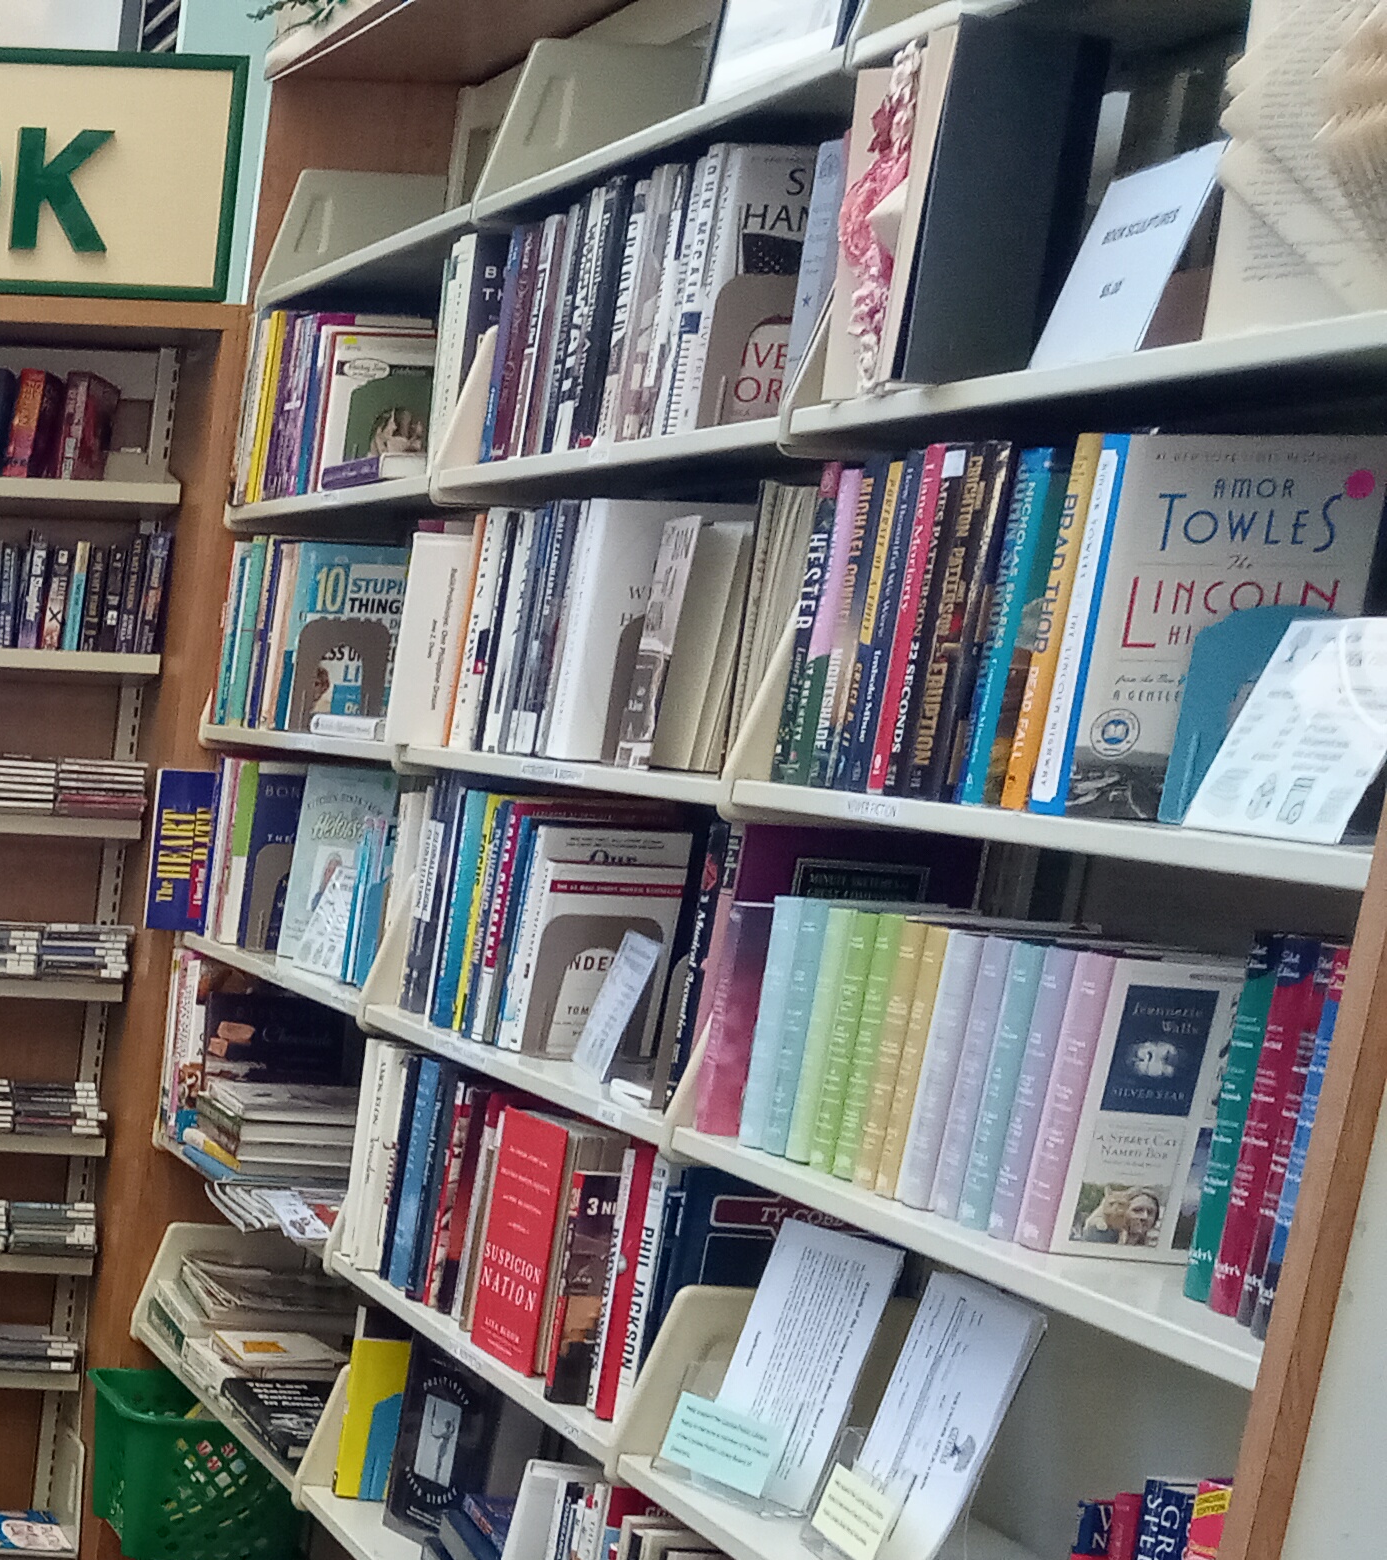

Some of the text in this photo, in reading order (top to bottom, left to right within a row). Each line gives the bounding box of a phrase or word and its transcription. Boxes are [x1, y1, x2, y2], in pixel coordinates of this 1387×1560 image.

[1158, 493, 1344, 553] TOWLES
[1213, 477, 1295, 499] AMOR
[1007, 481, 1036, 577] NICHOLAS
[1051, 493, 1078, 571] BRAD
[315, 566, 345, 611] 10
[350, 577, 406, 594] STUPI
[795, 533, 828, 630] HESTER
[909, 641, 920, 659] 22
[1035, 581, 1060, 654] THOR
[815, 648, 843, 751] NIGHTSHADE
[891, 663, 916, 754] SECONDS
[156, 808, 196, 879] HEART
[481, 1265, 538, 1314] NATION
[484, 1240, 542, 1285] SUSPICION
[620, 1277, 645, 1371] JACKSON
